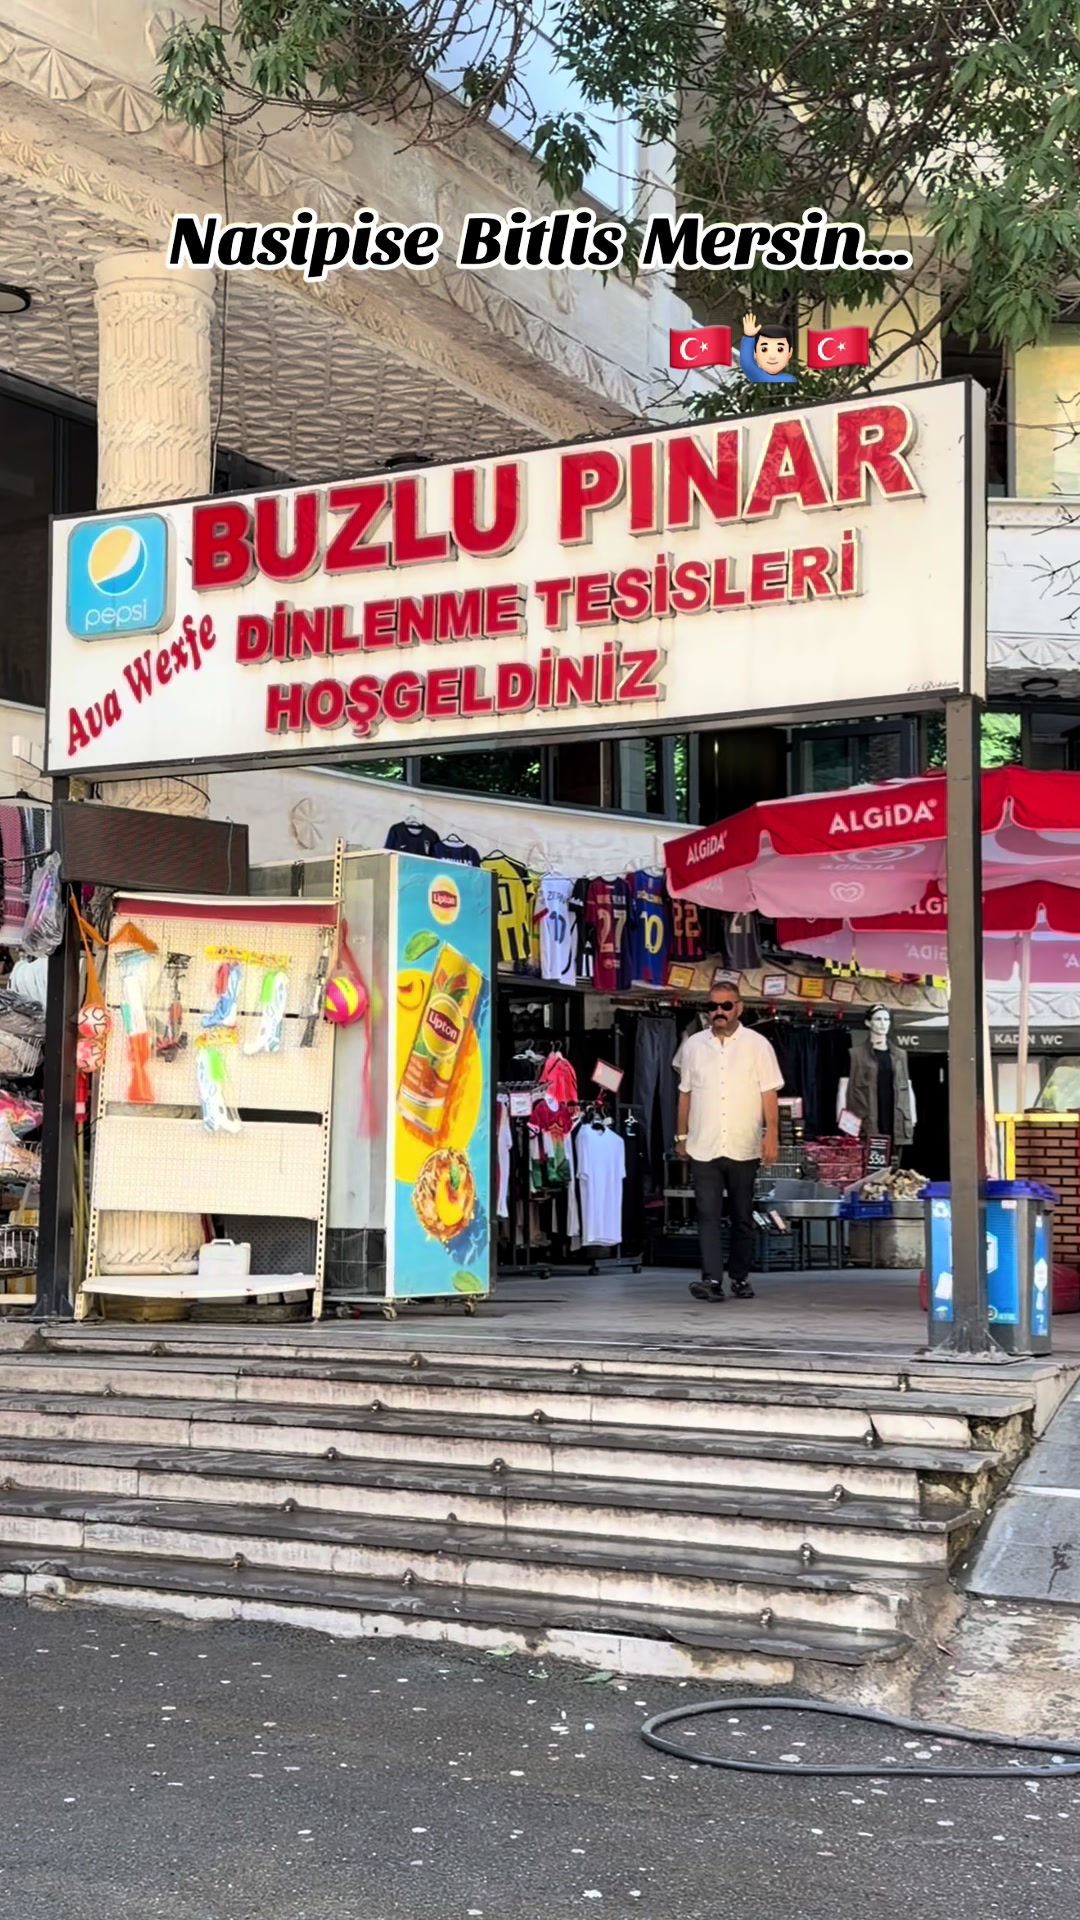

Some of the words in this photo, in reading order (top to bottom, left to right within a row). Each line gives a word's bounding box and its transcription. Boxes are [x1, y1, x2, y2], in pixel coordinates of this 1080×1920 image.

[191, 461, 524, 591] BUZLU
[558, 401, 923, 546] PINAR
[85, 599, 148, 631] pepsi
[235, 583, 524, 664] DİNLENME
[535, 527, 862, 630] TESİSLERİ
[265, 641, 664, 737] HOŞGELDİNİZ
[67, 688, 123, 757] Ava
[597, 908, 627, 954] 27
[640, 911, 664, 954] 10
[429, 1010, 458, 1040] Lipton
[897, 1036, 920, 1046] WC
[994, 1033, 1036, 1045] KADN
[1040, 1034, 1063, 1045] WC
